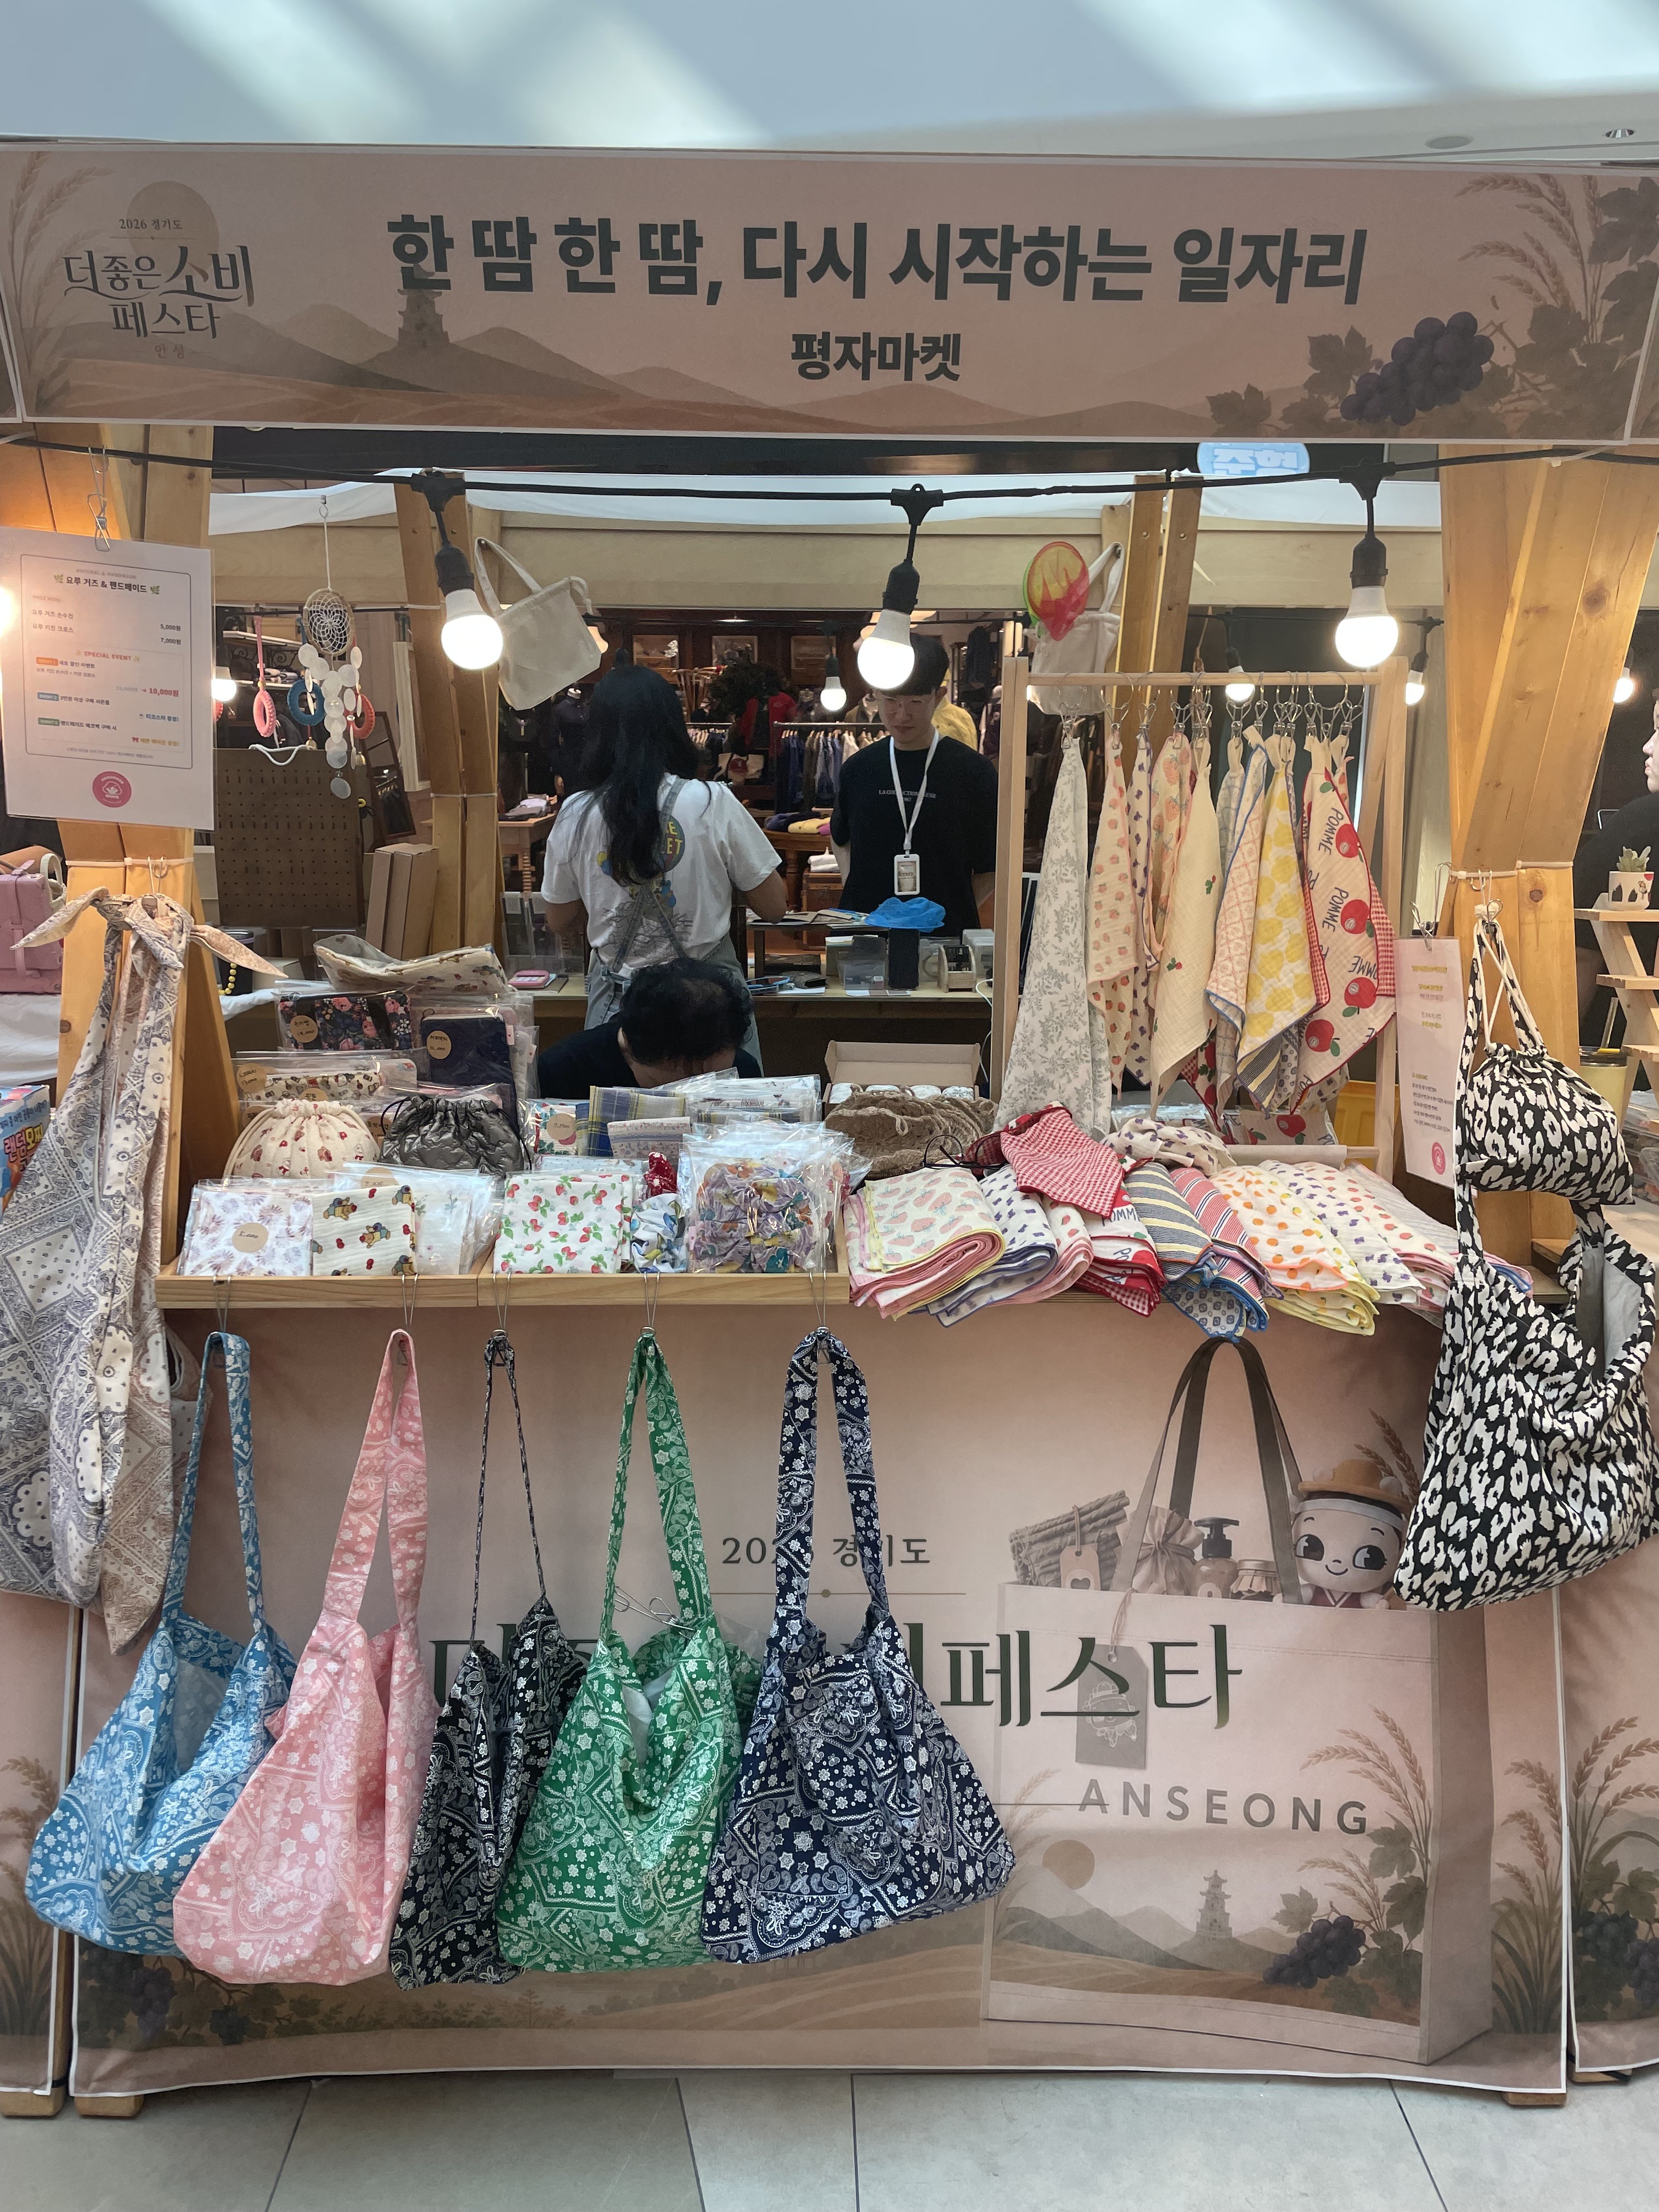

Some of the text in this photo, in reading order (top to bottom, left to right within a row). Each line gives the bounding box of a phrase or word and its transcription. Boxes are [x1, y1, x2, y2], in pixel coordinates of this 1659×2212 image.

[119, 218, 183, 231] 2026 경기도
[387, 215, 1368, 306] 한 땀 한 땀, 다시 시작하는 일자리
[108, 302, 221, 339] 페스타
[791, 331, 962, 382] 평자마켓
[66, 575, 147, 593] 요루 거즈 & 핸드메이드
[160, 623, 180, 631] 5,000원
[160, 637, 180, 645] 7,000원
[149, 687, 178, 697] 10,000원
[1318, 807, 1344, 856] POMME
[1322, 887, 1349, 933] POMME
[722, 1537, 814, 1565] 20
[1077, 1779, 1369, 1835] ANSEONG
